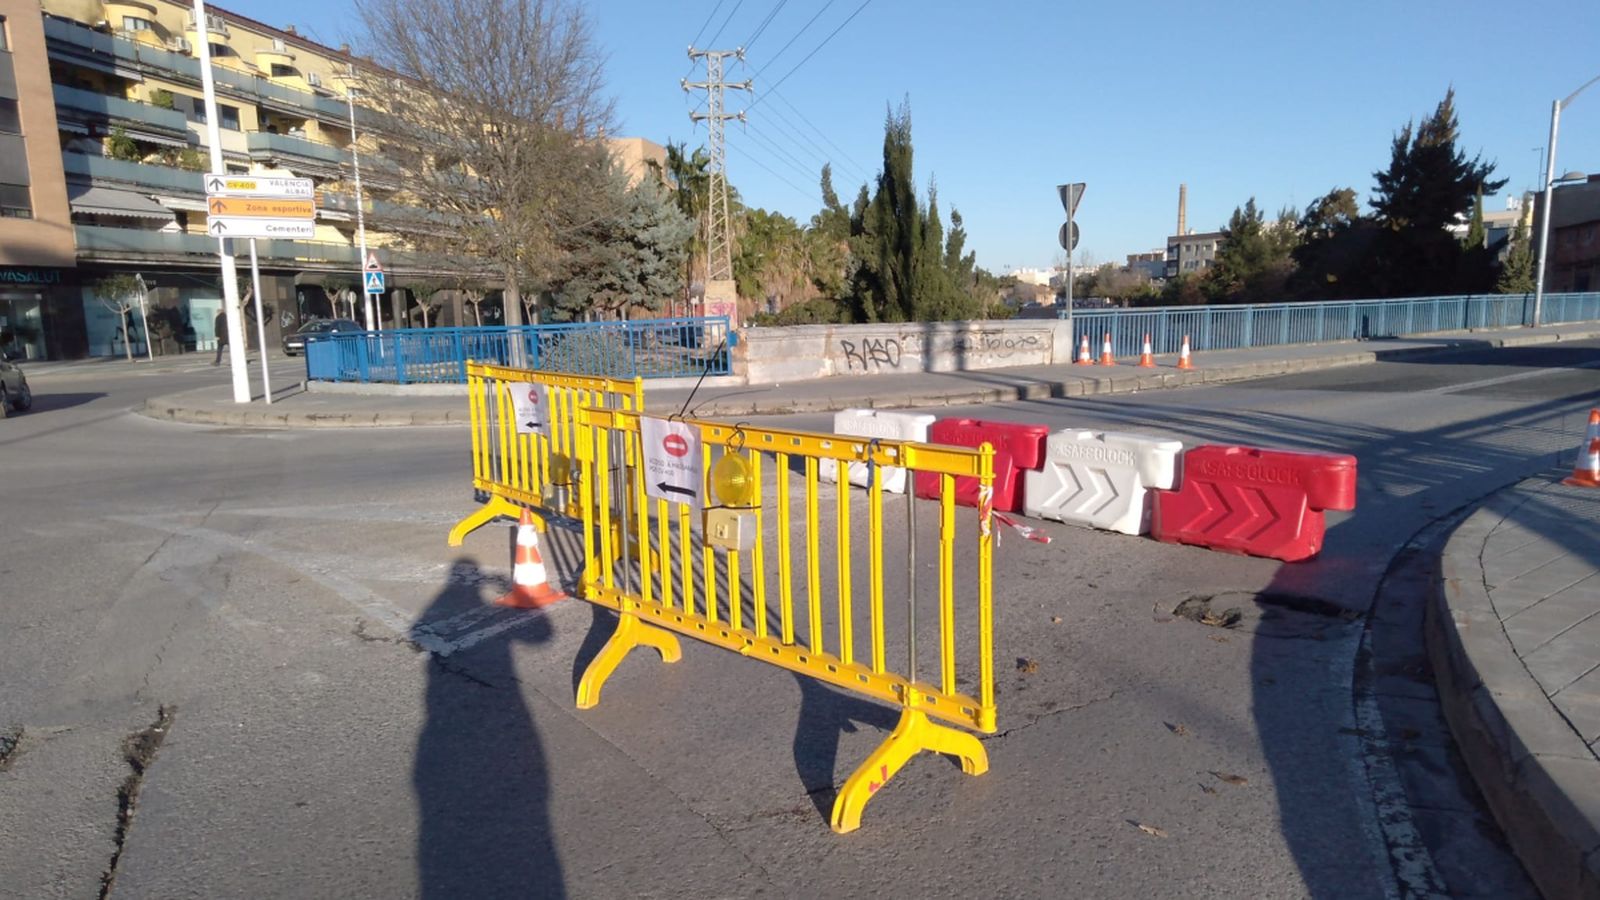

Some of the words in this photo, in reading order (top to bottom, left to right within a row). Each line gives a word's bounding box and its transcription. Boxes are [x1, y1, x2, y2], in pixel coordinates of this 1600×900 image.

[246, 203, 268, 211] Zona
[272, 205, 312, 213] esportiva
[266, 225, 312, 233] Cementeri
